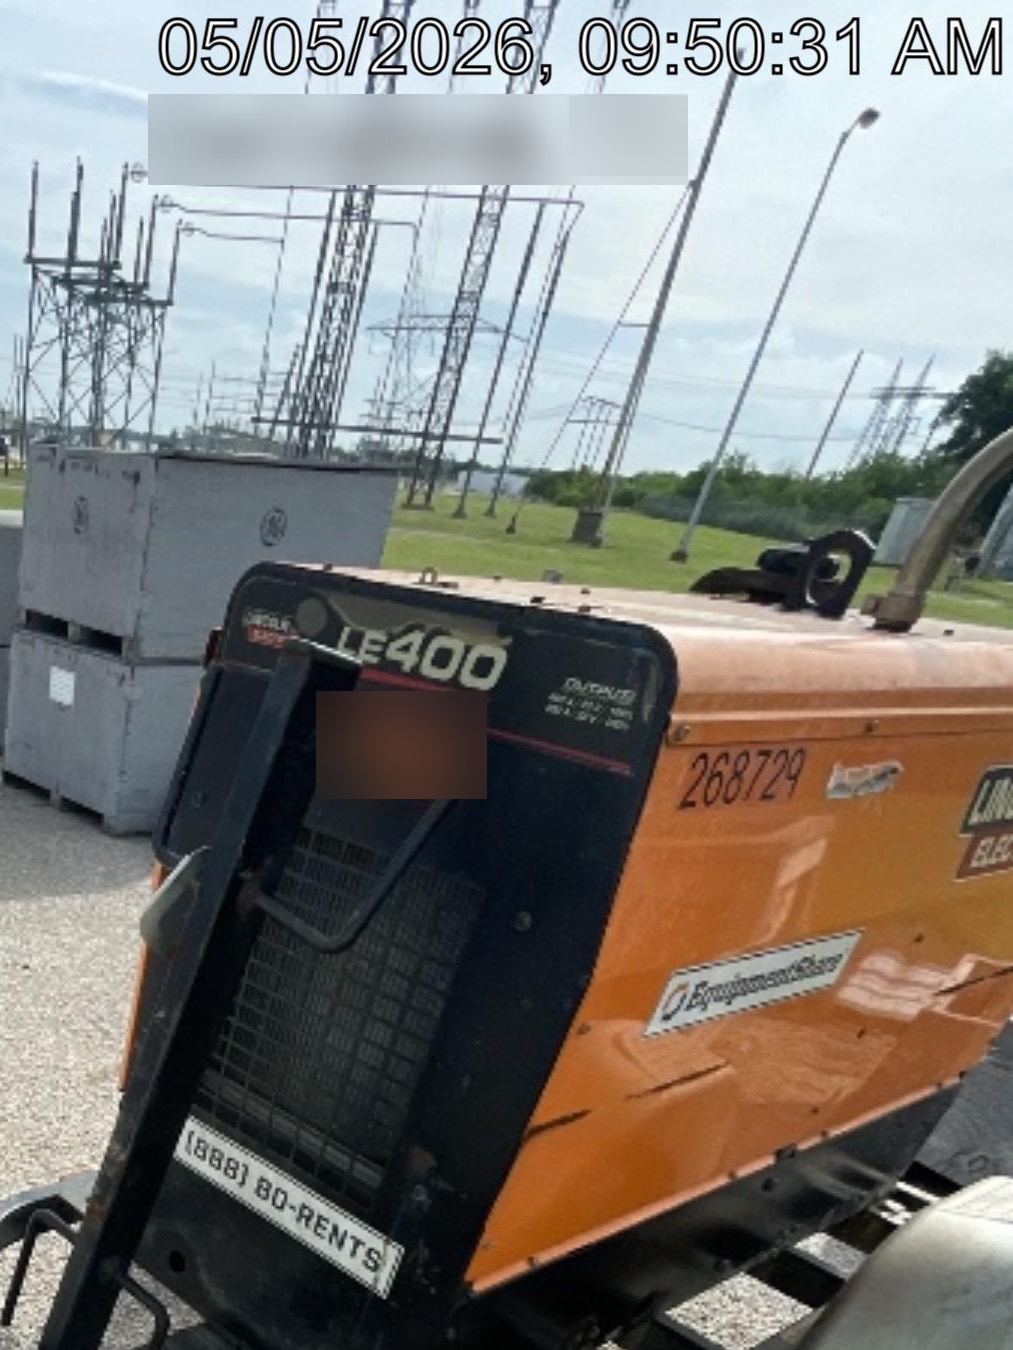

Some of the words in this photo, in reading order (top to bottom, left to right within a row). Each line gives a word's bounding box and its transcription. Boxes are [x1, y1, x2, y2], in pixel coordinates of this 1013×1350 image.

[337, 626, 507, 691] LE400
[678, 747, 807, 809] 268729
[683, 953, 844, 1012] EquipmentShare
[185, 1130, 249, 1188] (888)
[253, 1175, 383, 1273] 80-RENTS
